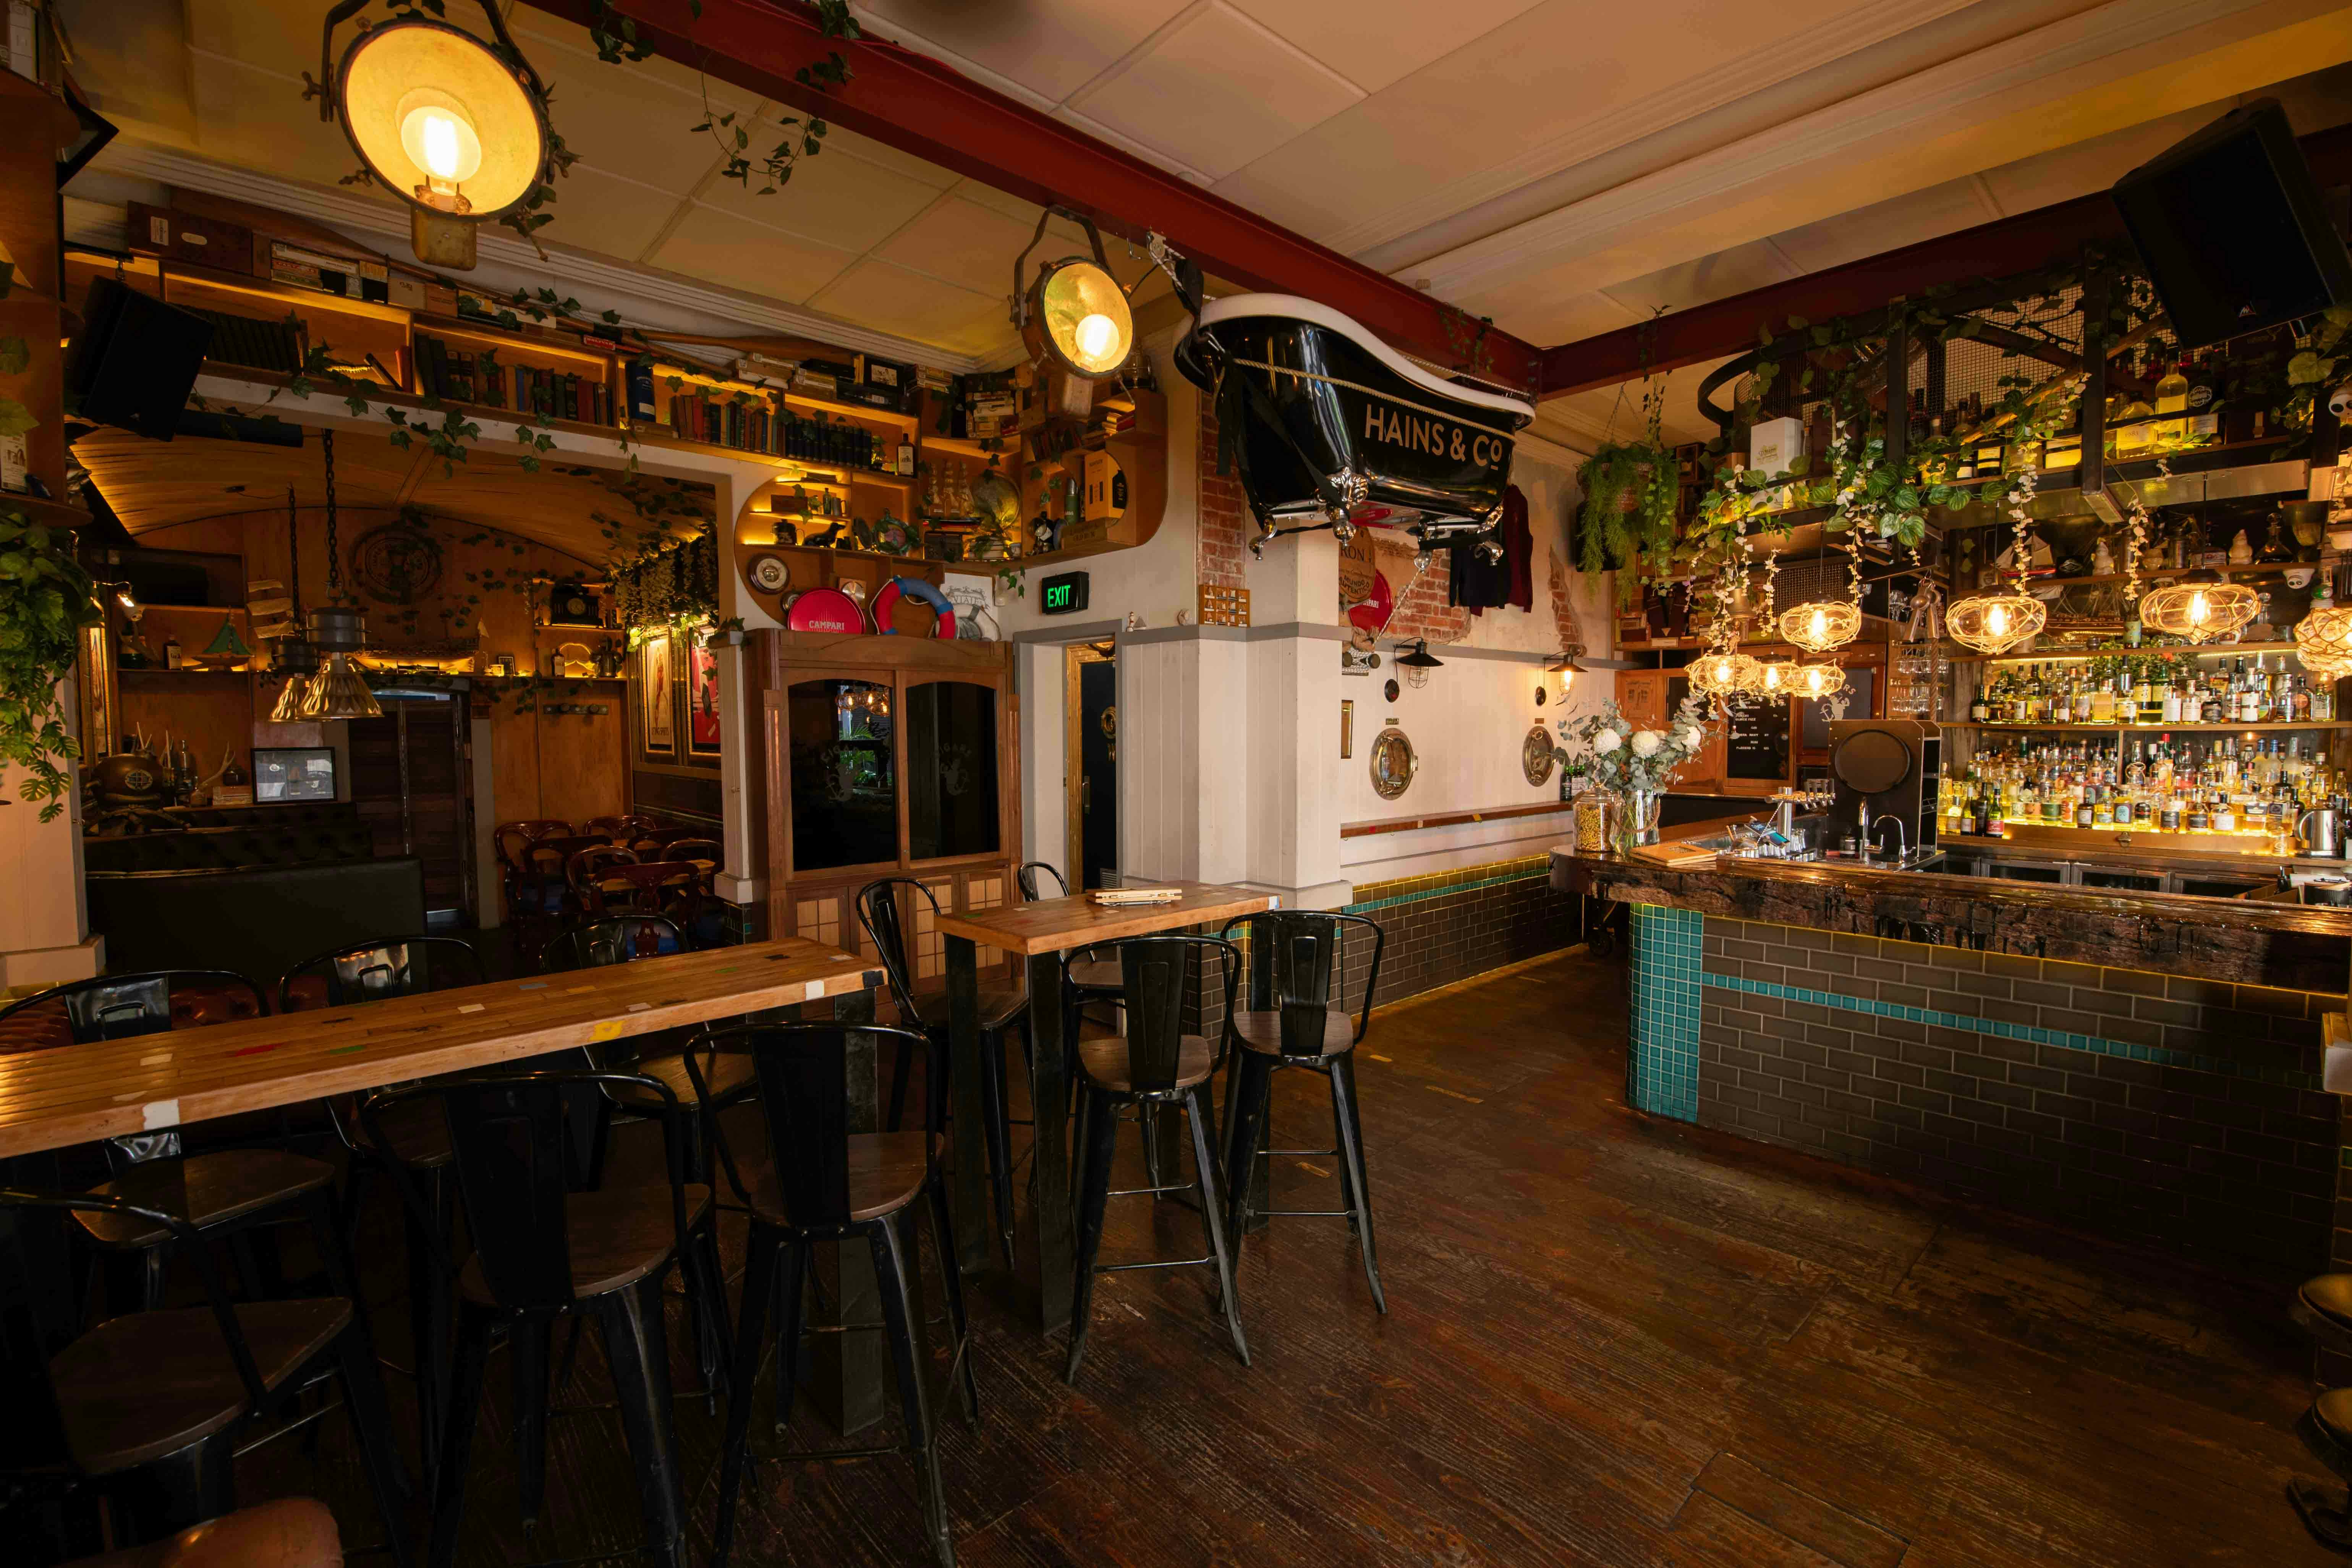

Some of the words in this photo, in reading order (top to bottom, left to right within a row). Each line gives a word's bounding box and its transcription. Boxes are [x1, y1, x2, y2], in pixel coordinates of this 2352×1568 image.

[1365, 403, 1444, 455] HAINS
[1450, 428, 1466, 462] &
[1344, 575, 1365, 587] MUNDO
[1047, 585, 1071, 608] EXIT
[809, 620, 845, 630] CAMPARI
